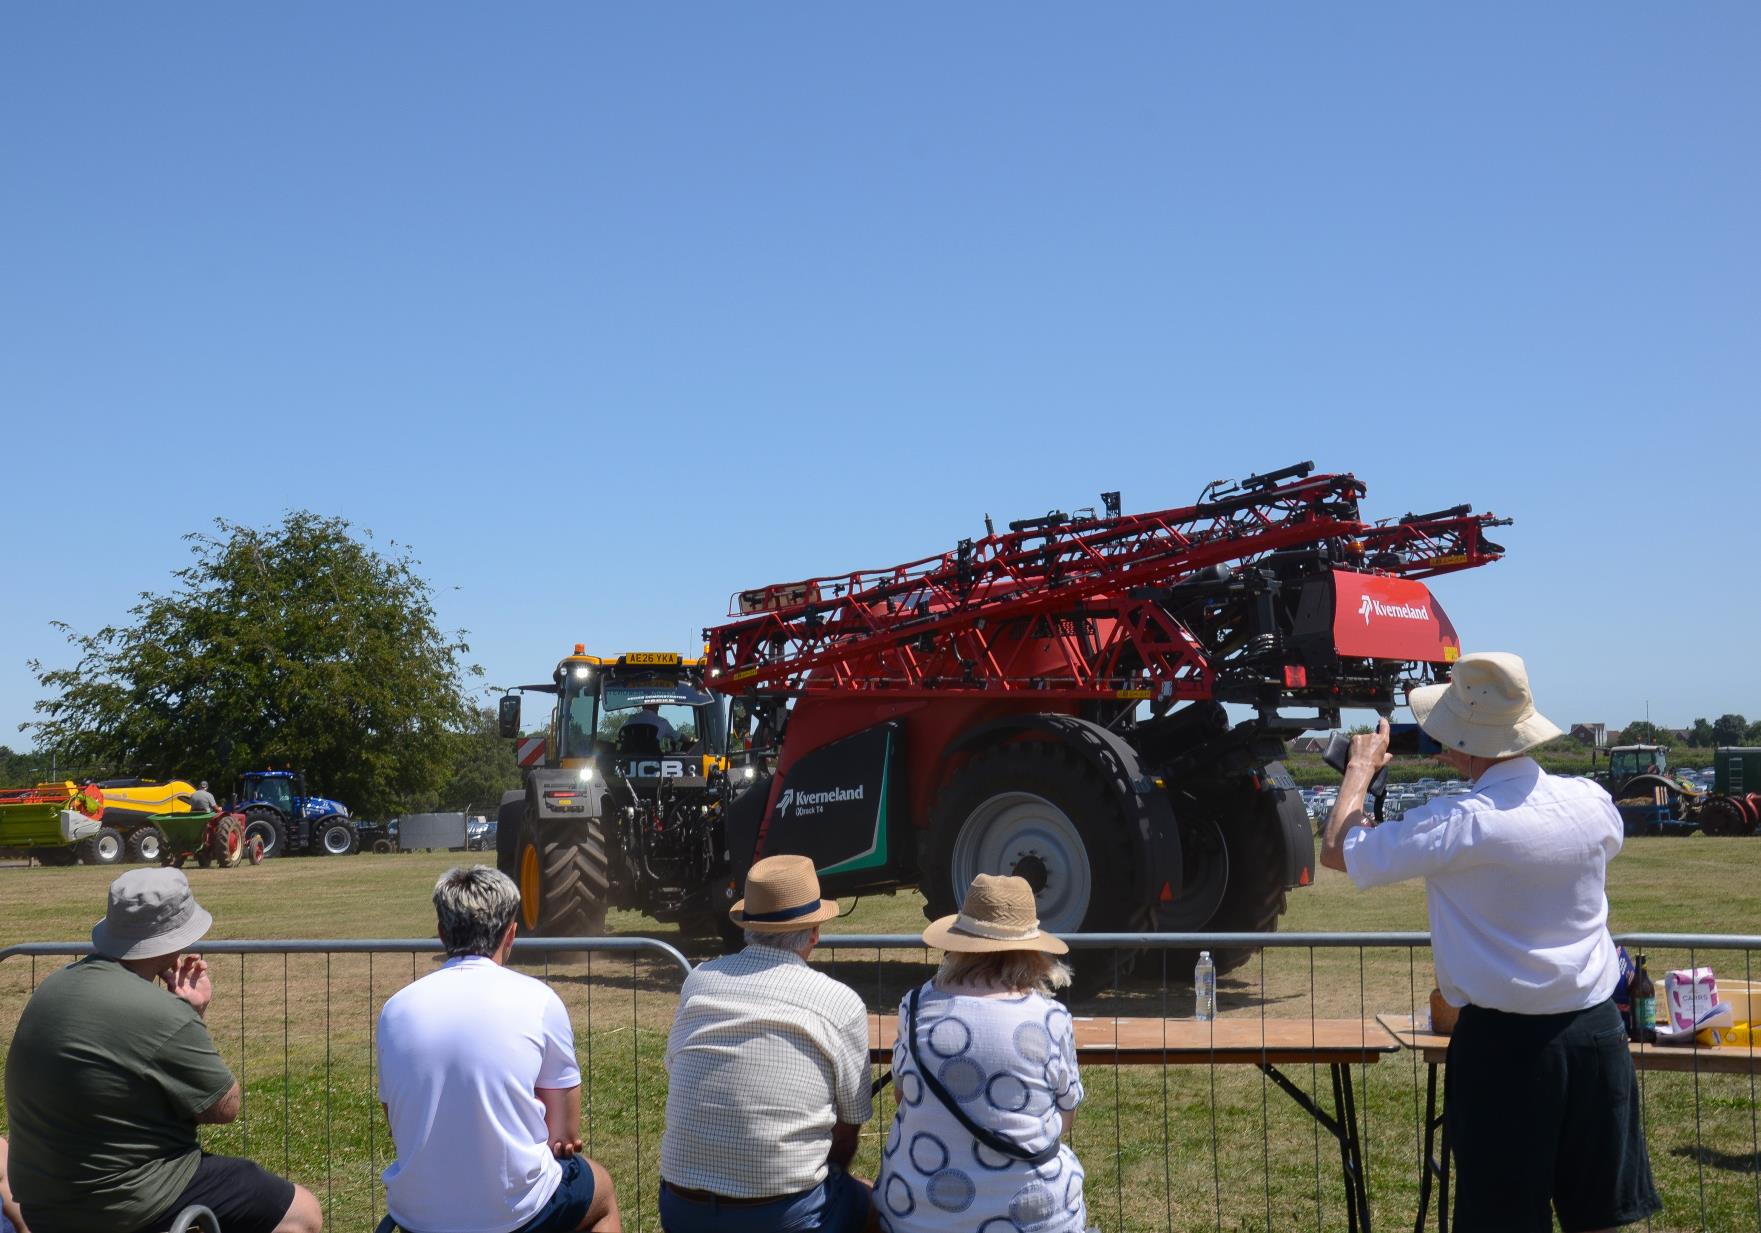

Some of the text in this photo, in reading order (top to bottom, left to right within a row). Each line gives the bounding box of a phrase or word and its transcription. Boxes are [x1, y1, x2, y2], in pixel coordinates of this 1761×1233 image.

[1372, 600, 1429, 620] Kverneland
[630, 653, 674, 663] AE26 YKA
[625, 761, 684, 778] JCB
[796, 784, 864, 806] Kverneland
